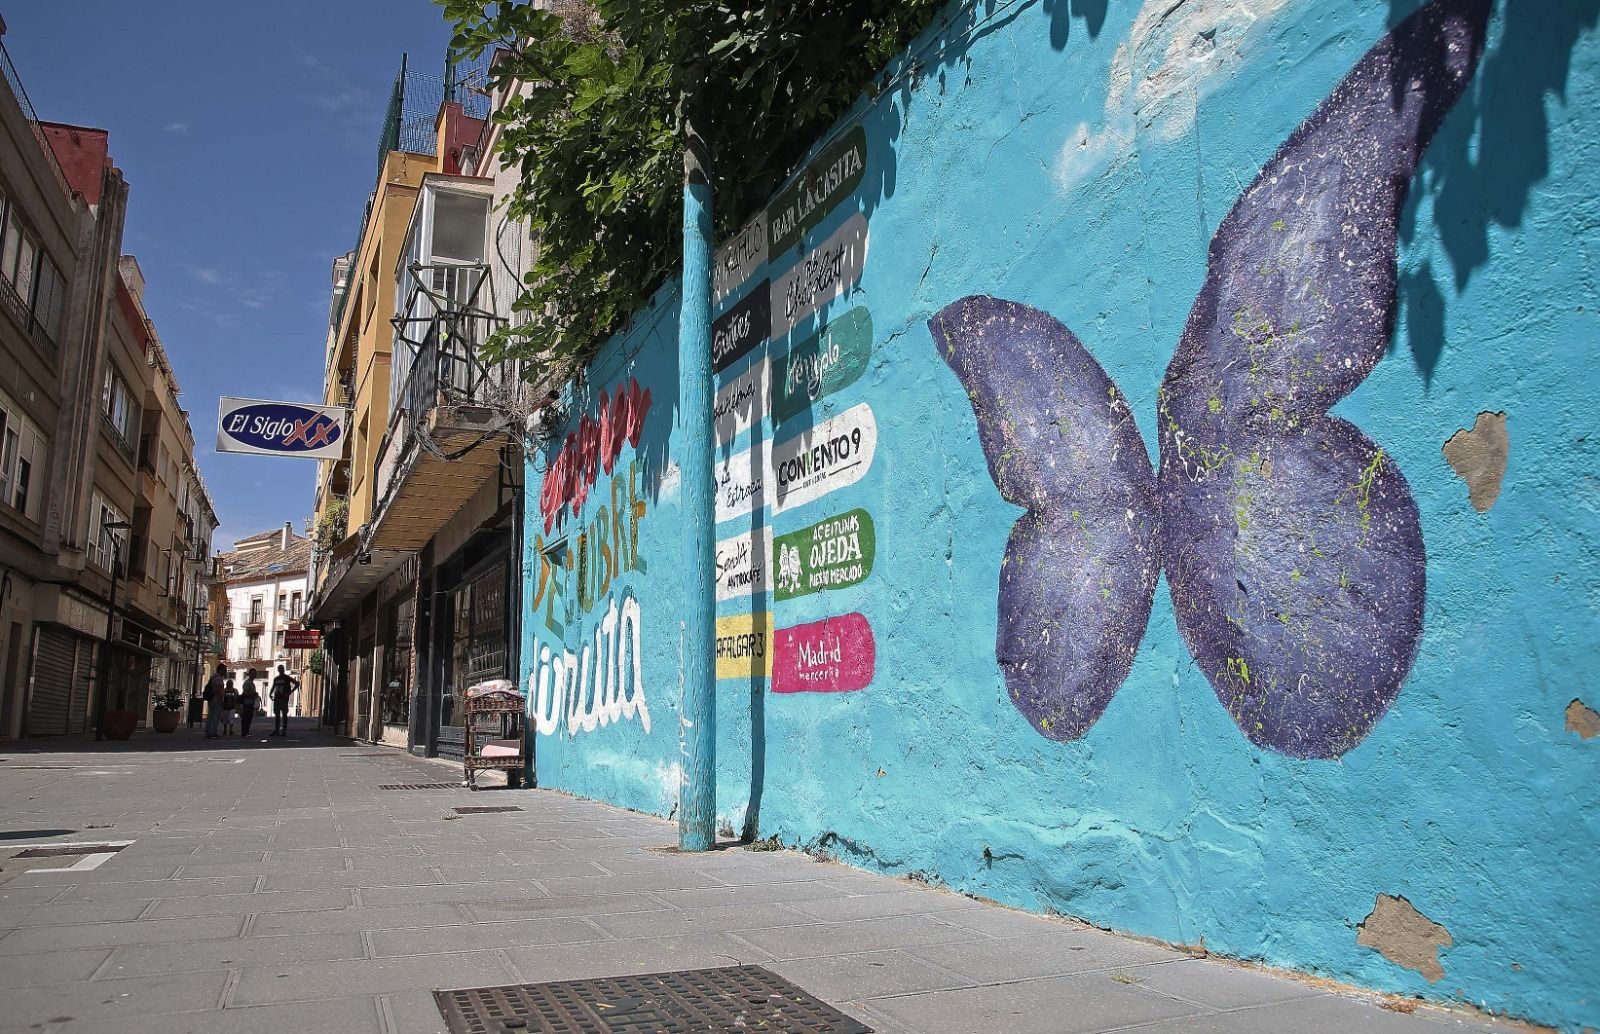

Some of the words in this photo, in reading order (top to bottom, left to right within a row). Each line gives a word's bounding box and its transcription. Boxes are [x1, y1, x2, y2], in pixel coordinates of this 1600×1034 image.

[772, 205, 797, 245] BAR
[797, 186, 816, 223] LA
[815, 145, 863, 202] CASITA
[227, 414, 249, 433] El
[249, 416, 294, 441] Siglo
[281, 410, 341, 449] XX
[778, 434, 850, 487] CONVENTO
[850, 427, 862, 455] 9
[812, 514, 860, 541] ACEITUNAS
[531, 459, 648, 641] DECUBRE
[809, 532, 863, 568] OJEDA
[830, 563, 863, 585] MERCADO
[716, 633, 757, 659] AFALGAR
[756, 632, 764, 658] 3
[797, 636, 842, 669] Madrid
[527, 595, 651, 737] diruta
